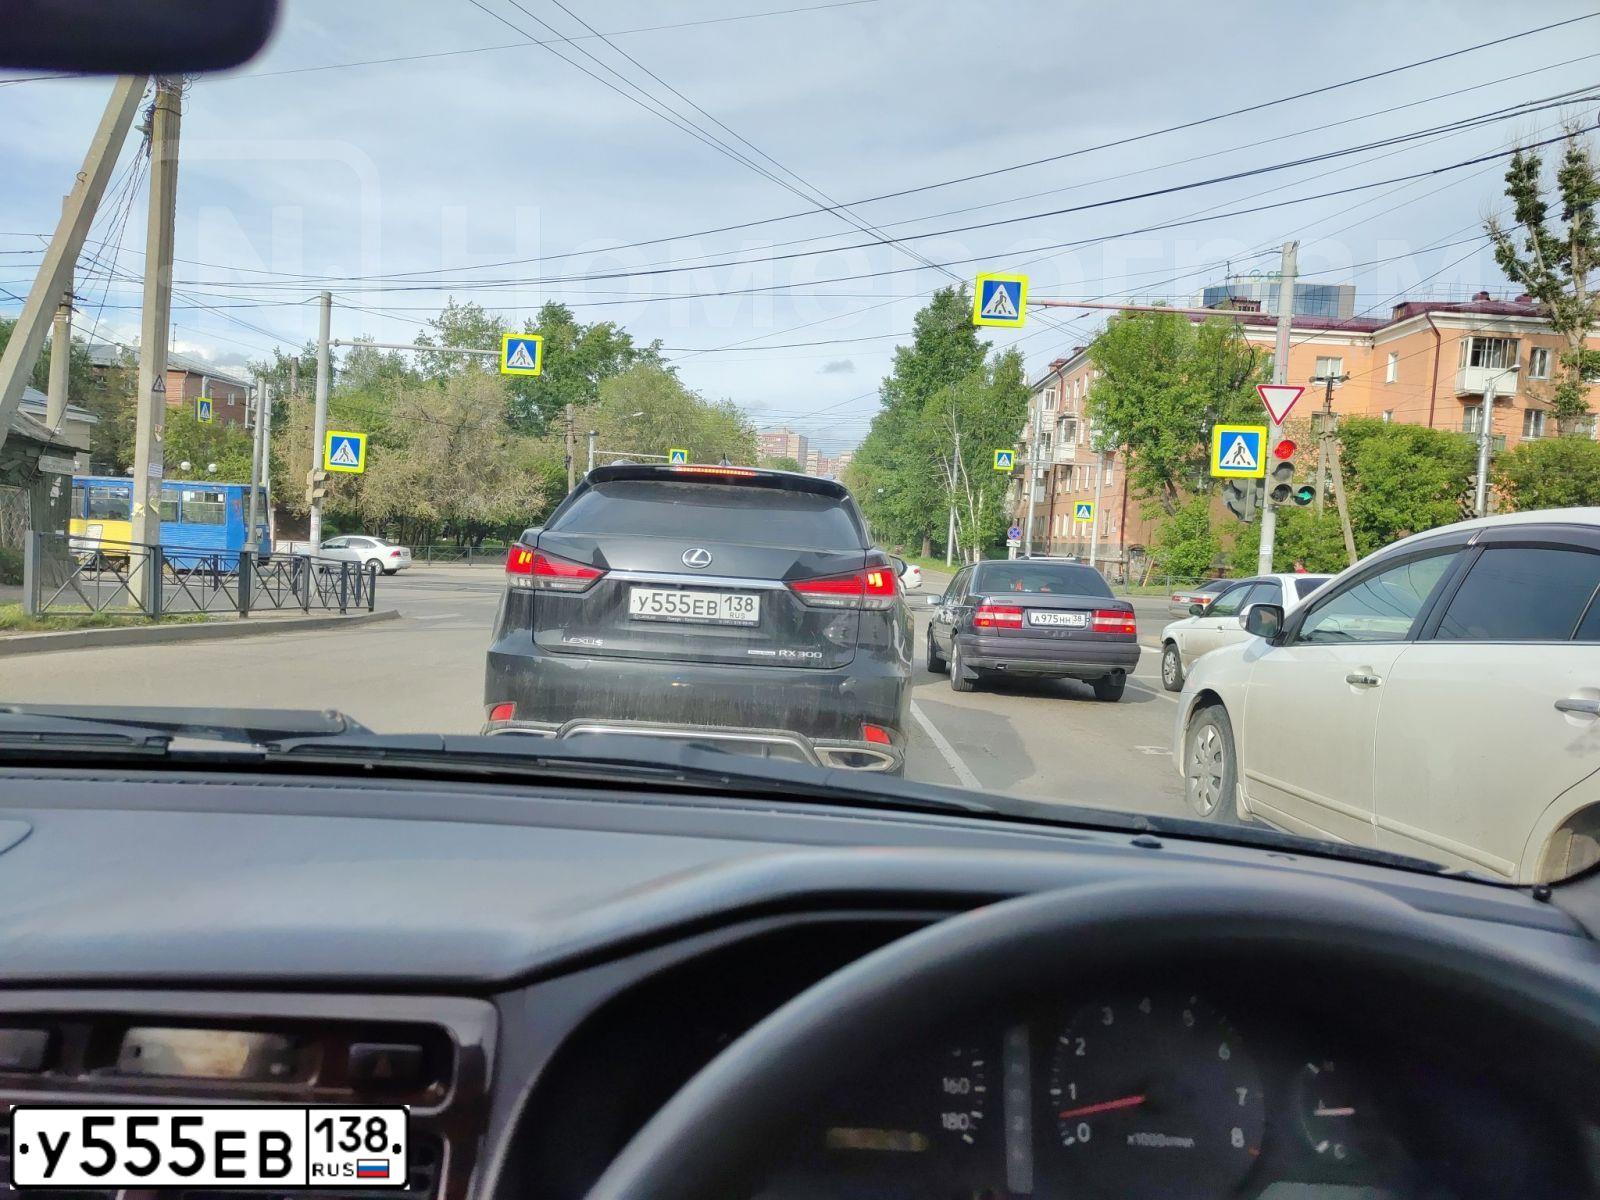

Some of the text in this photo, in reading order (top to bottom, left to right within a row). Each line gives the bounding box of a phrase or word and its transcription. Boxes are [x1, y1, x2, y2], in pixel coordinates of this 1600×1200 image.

[637, 592, 754, 616] У555ЕВ 138
[729, 612, 746, 620] RUS
[1034, 614, 1071, 624] А975НН
[778, 649, 796, 659] RX
[1102, 1006, 1114, 1026] 3
[1075, 1037, 1086, 1056] 2
[1218, 1042, 1230, 1060] 6
[1067, 1083, 1077, 1099] 1
[1235, 1087, 1248, 1106] 7
[1076, 1122, 1090, 1143] 0
[1230, 1127, 1245, 1148] 8
